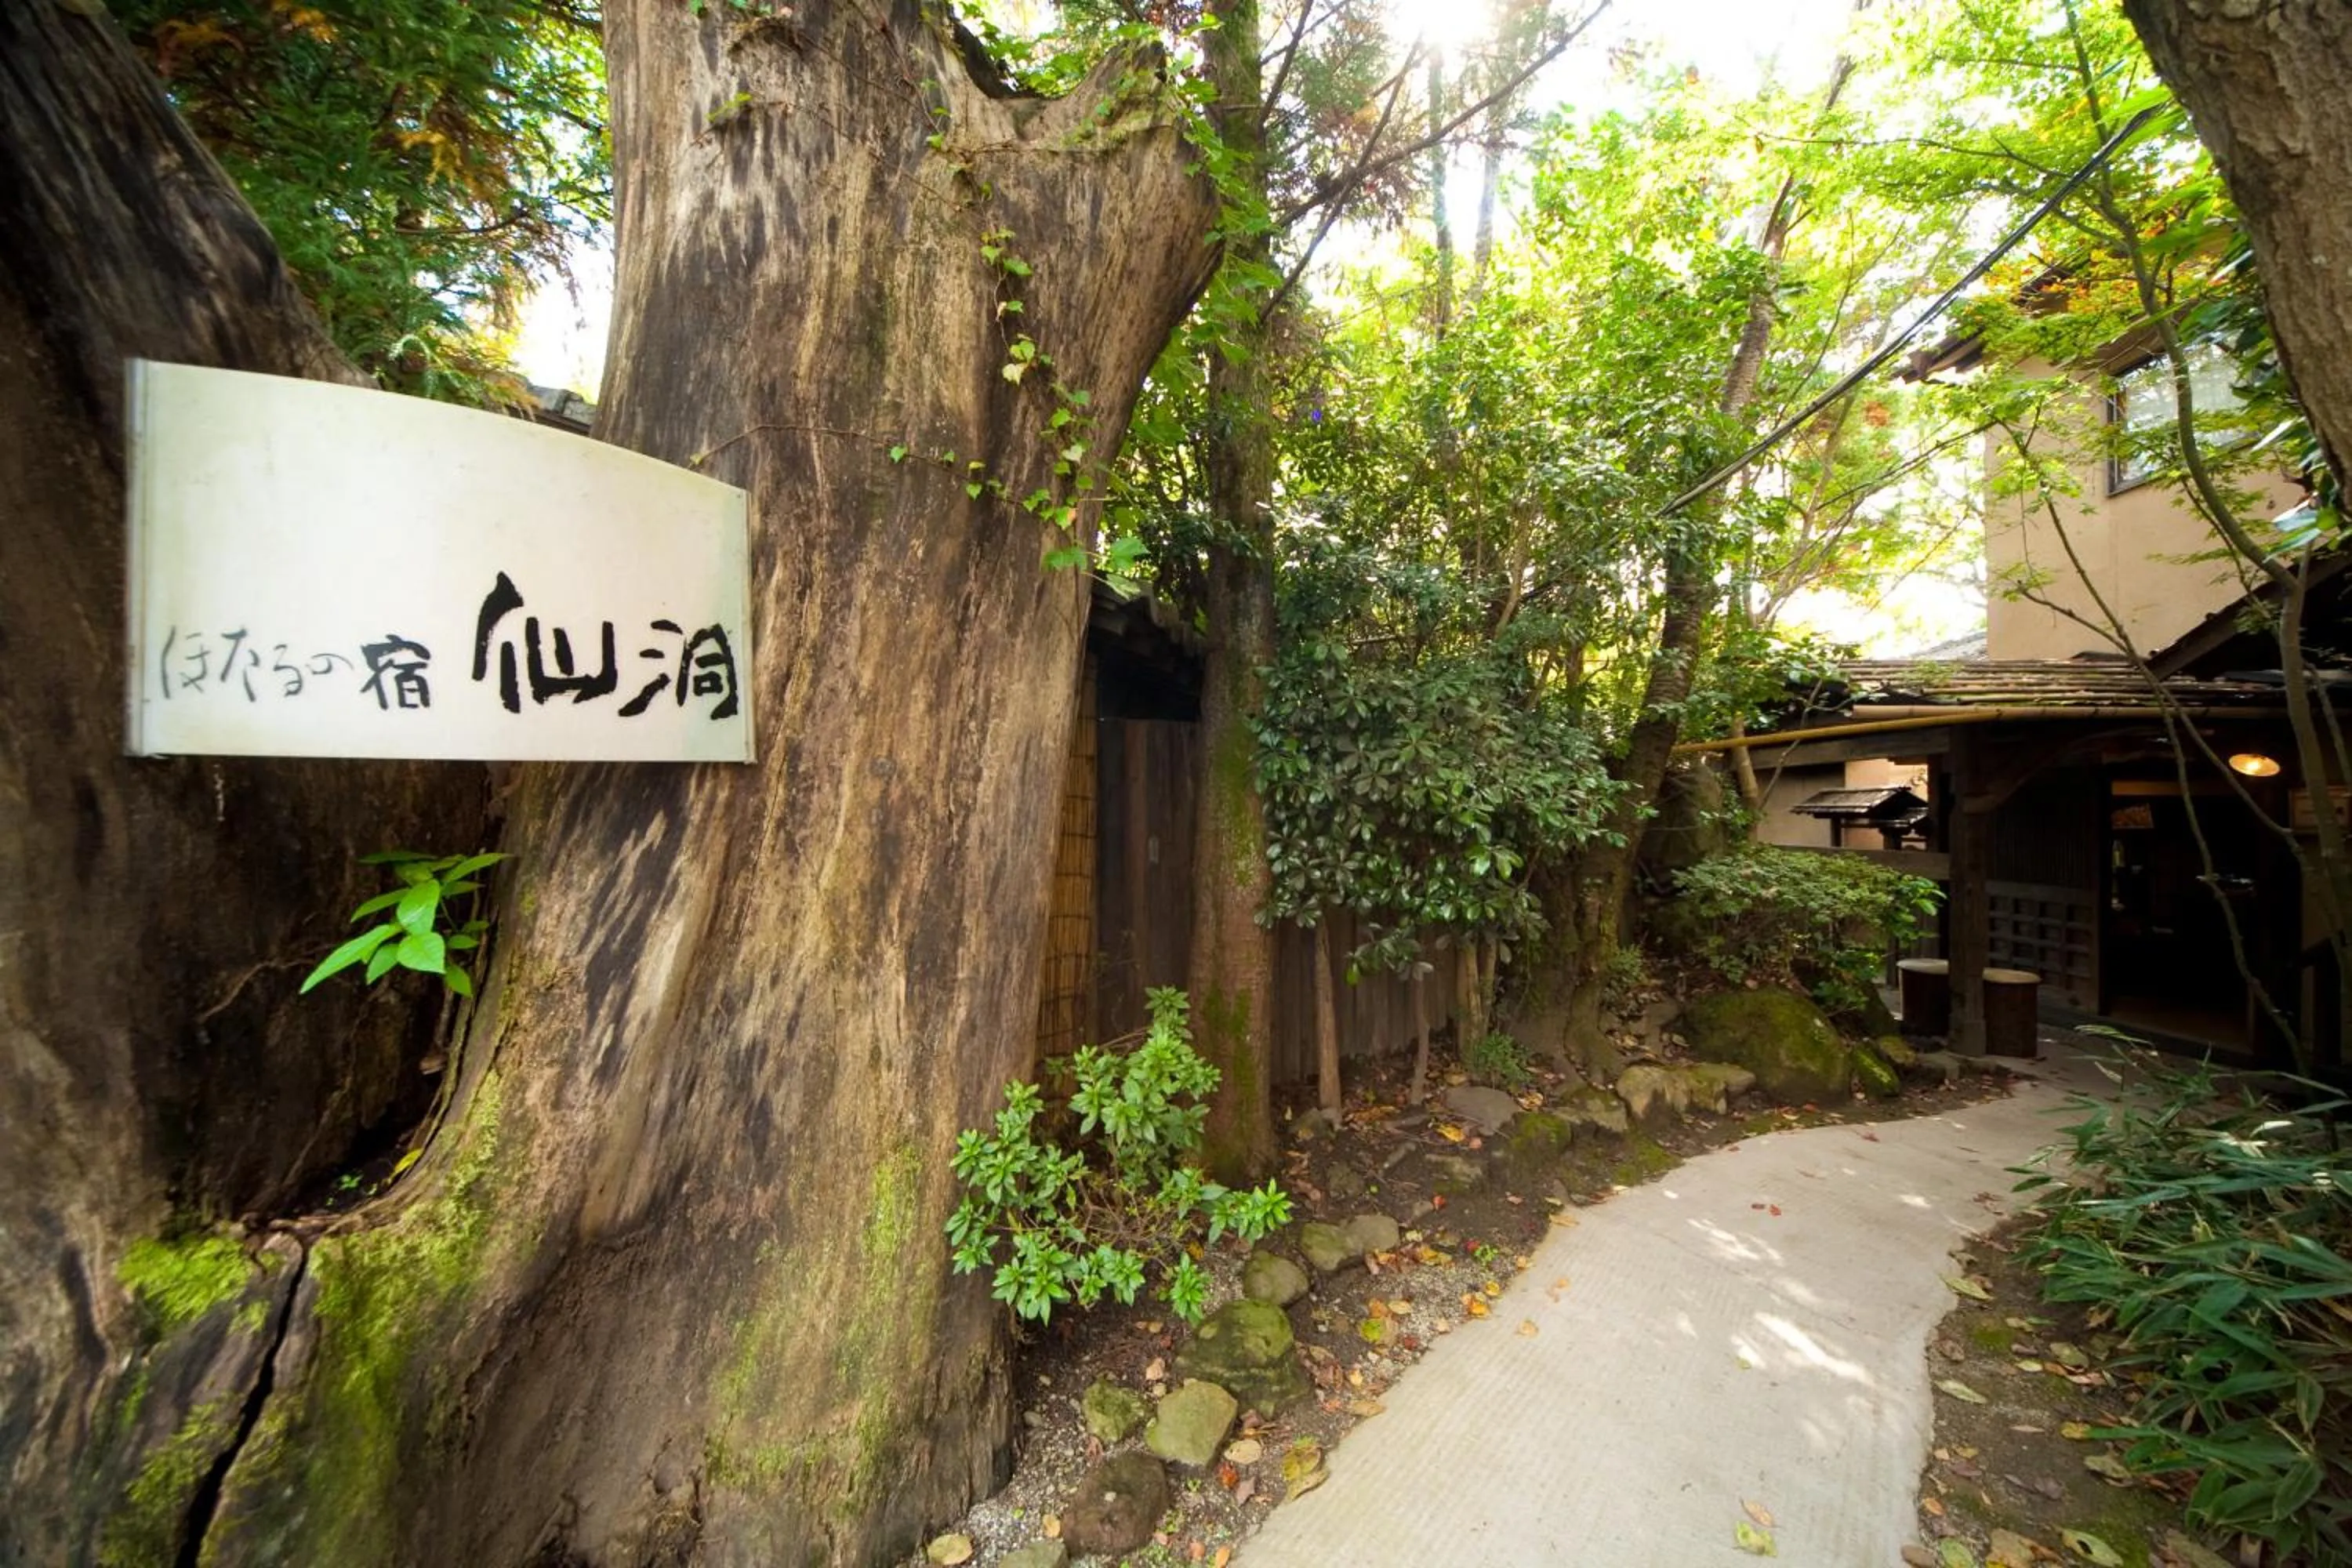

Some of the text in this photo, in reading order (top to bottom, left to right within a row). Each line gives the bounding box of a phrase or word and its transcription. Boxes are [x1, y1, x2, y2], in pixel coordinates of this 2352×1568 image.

[160, 571, 739, 721] ほたるの宿 仙洞
